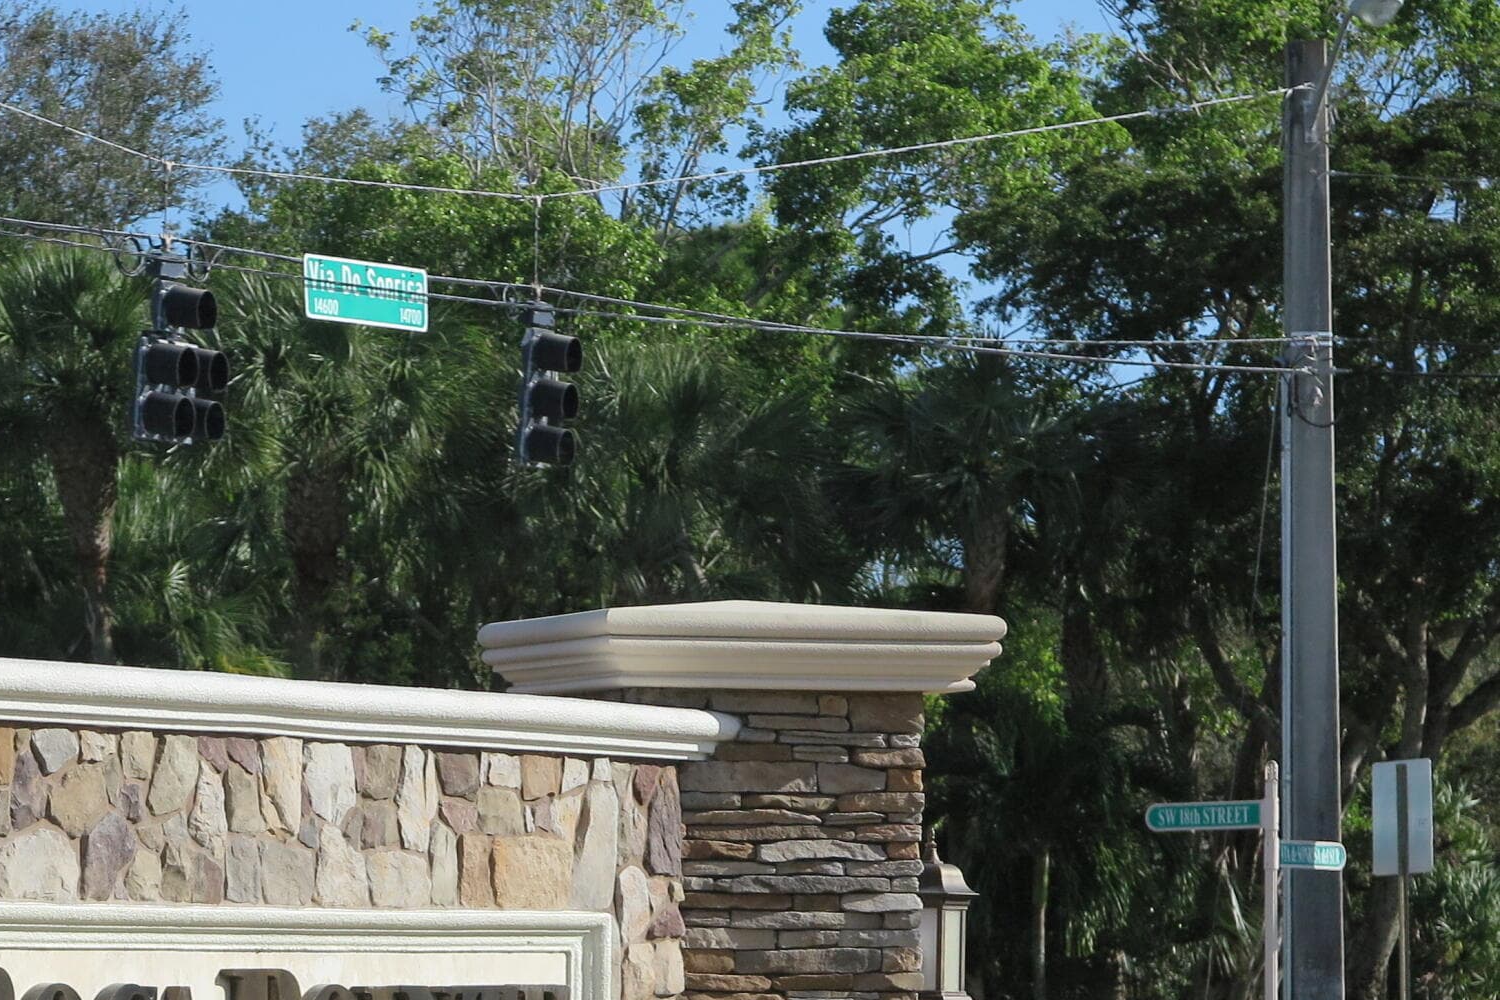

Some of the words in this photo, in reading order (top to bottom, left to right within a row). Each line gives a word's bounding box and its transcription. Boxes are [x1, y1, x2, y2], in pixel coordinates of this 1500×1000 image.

[307, 260, 335, 292] Via
[341, 265, 361, 297] De
[366, 268, 427, 304] Sonrisa
[314, 297, 339, 315] 14600
[1158, 808, 1177, 826] SW
[1180, 808, 1201, 825] 18th
[1203, 806, 1250, 824] STREET
